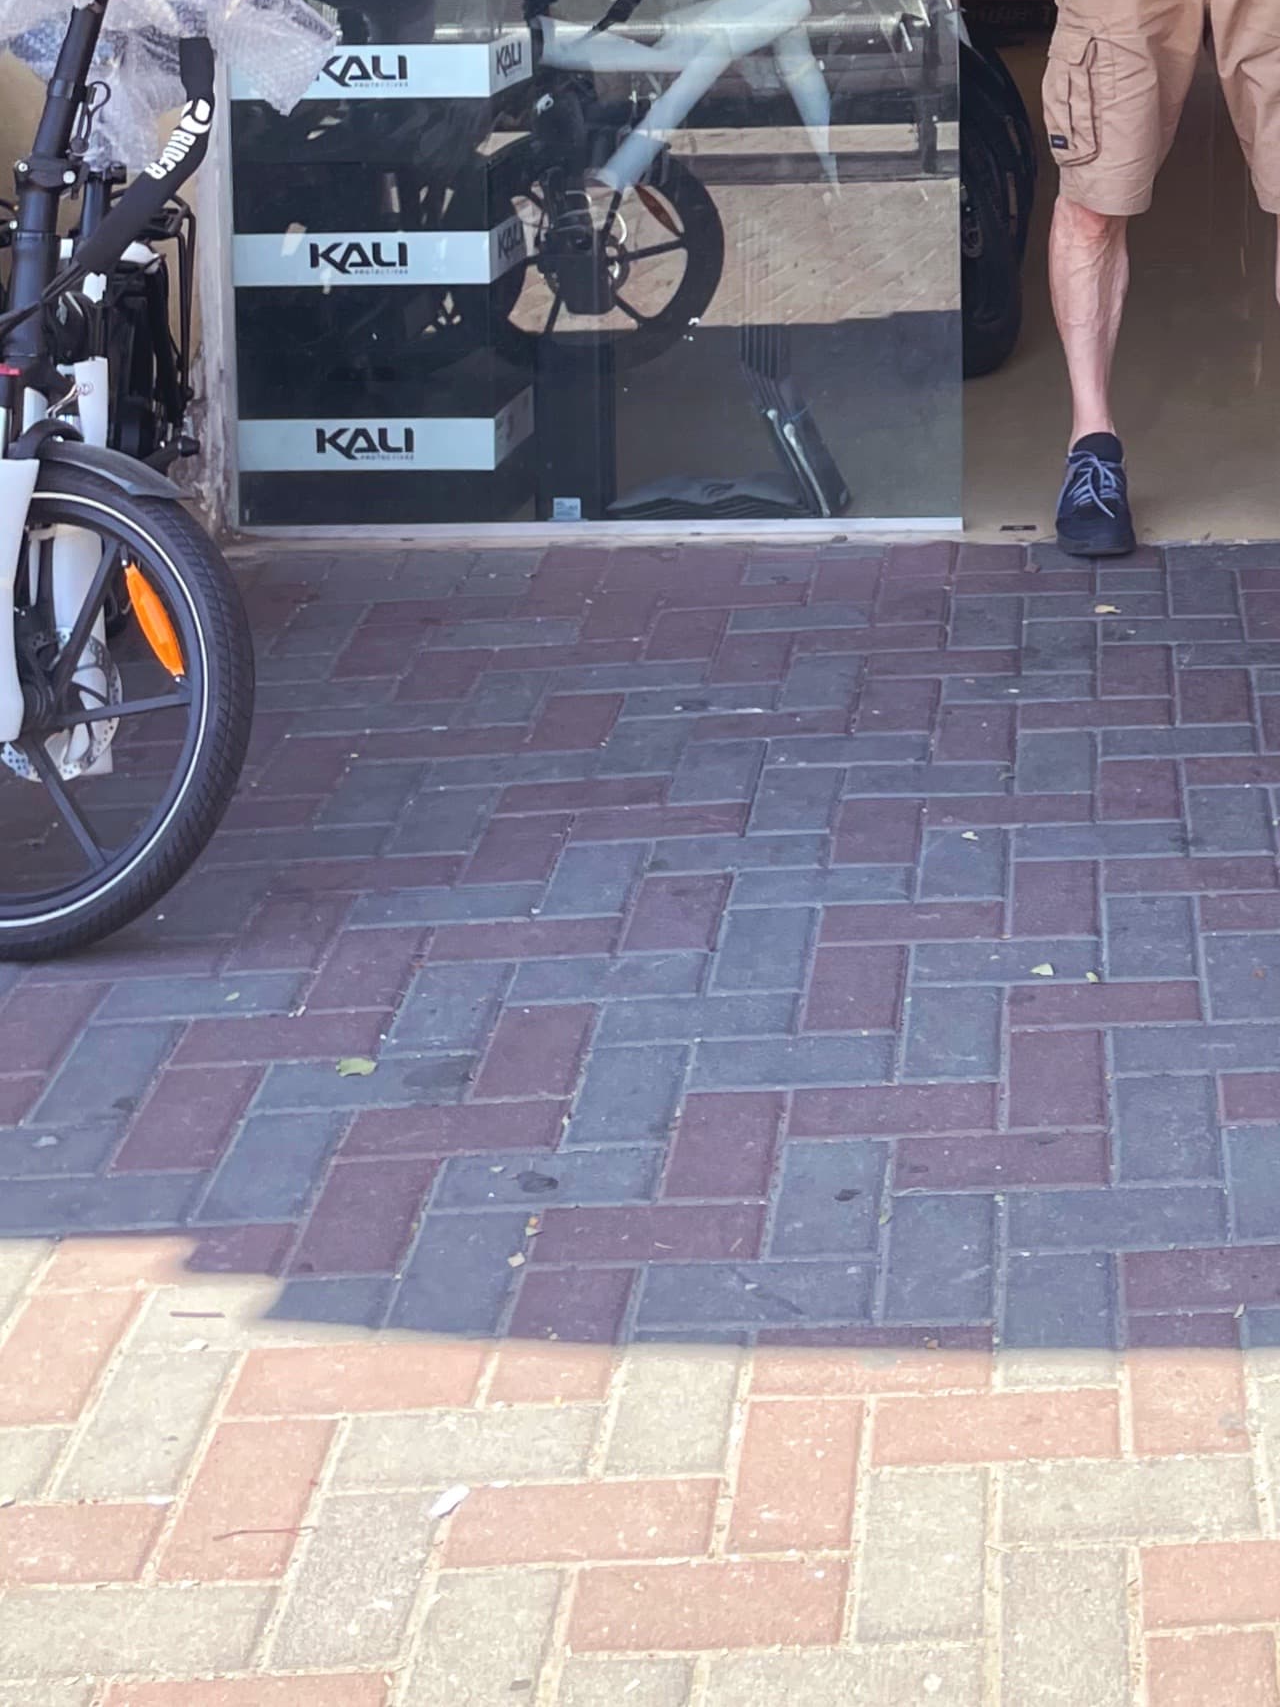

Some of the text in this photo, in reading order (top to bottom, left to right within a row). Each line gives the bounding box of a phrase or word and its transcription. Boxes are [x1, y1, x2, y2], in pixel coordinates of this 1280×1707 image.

[315, 54, 408, 88] KALI
[309, 242, 409, 275] KALI
[315, 426, 415, 461] KALI
